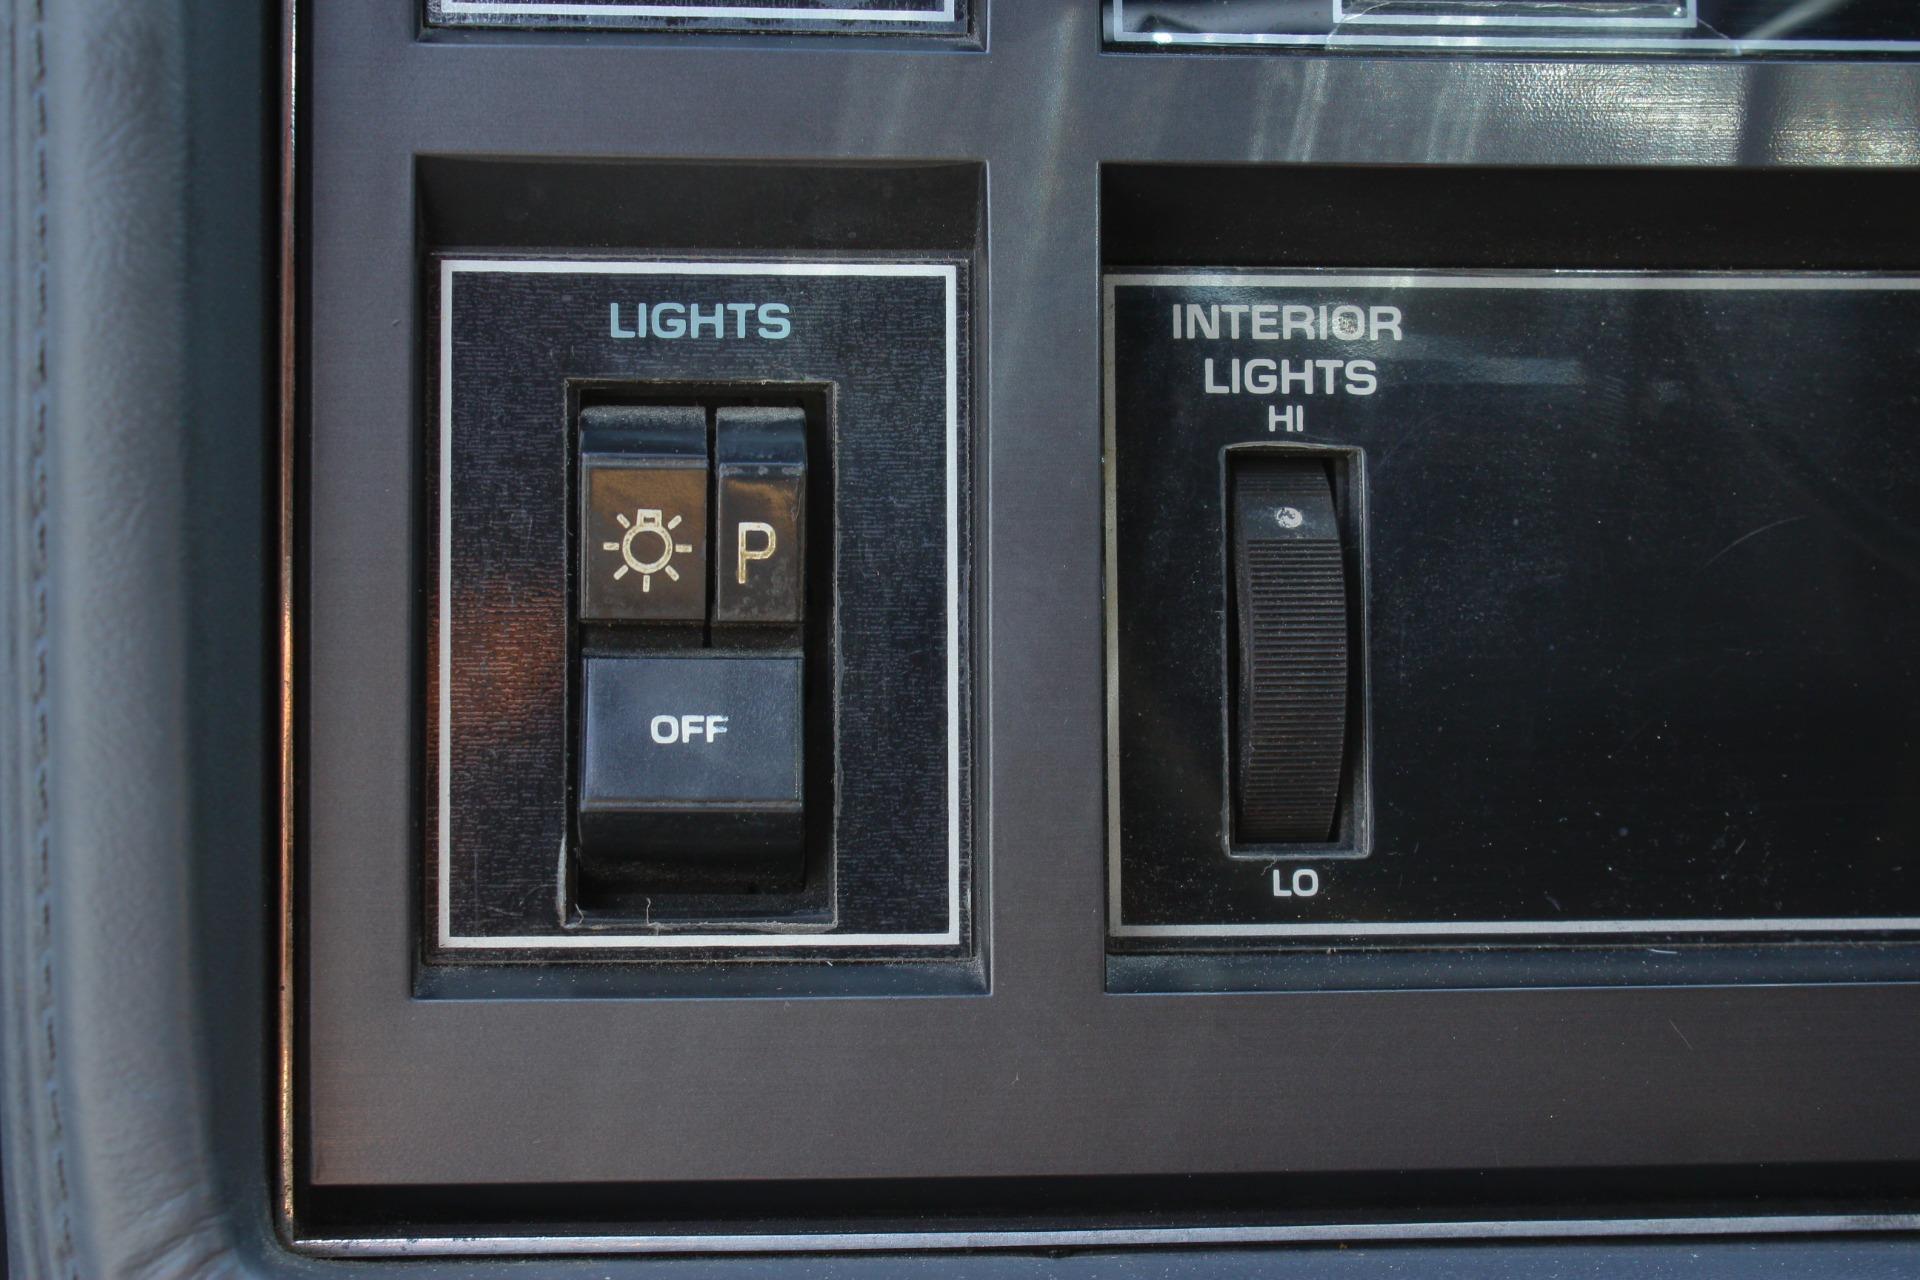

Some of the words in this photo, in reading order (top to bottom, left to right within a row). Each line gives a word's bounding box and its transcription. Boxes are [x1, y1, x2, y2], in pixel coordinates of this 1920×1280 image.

[610, 302, 792, 340] LIGHTS
[1172, 303, 1403, 341] INTERIOR
[1204, 358, 1378, 395] LIGHTS
[1268, 404, 1304, 433] HI
[737, 521, 778, 585] P
[649, 714, 730, 745] OFF
[1272, 868, 1319, 897] LO
